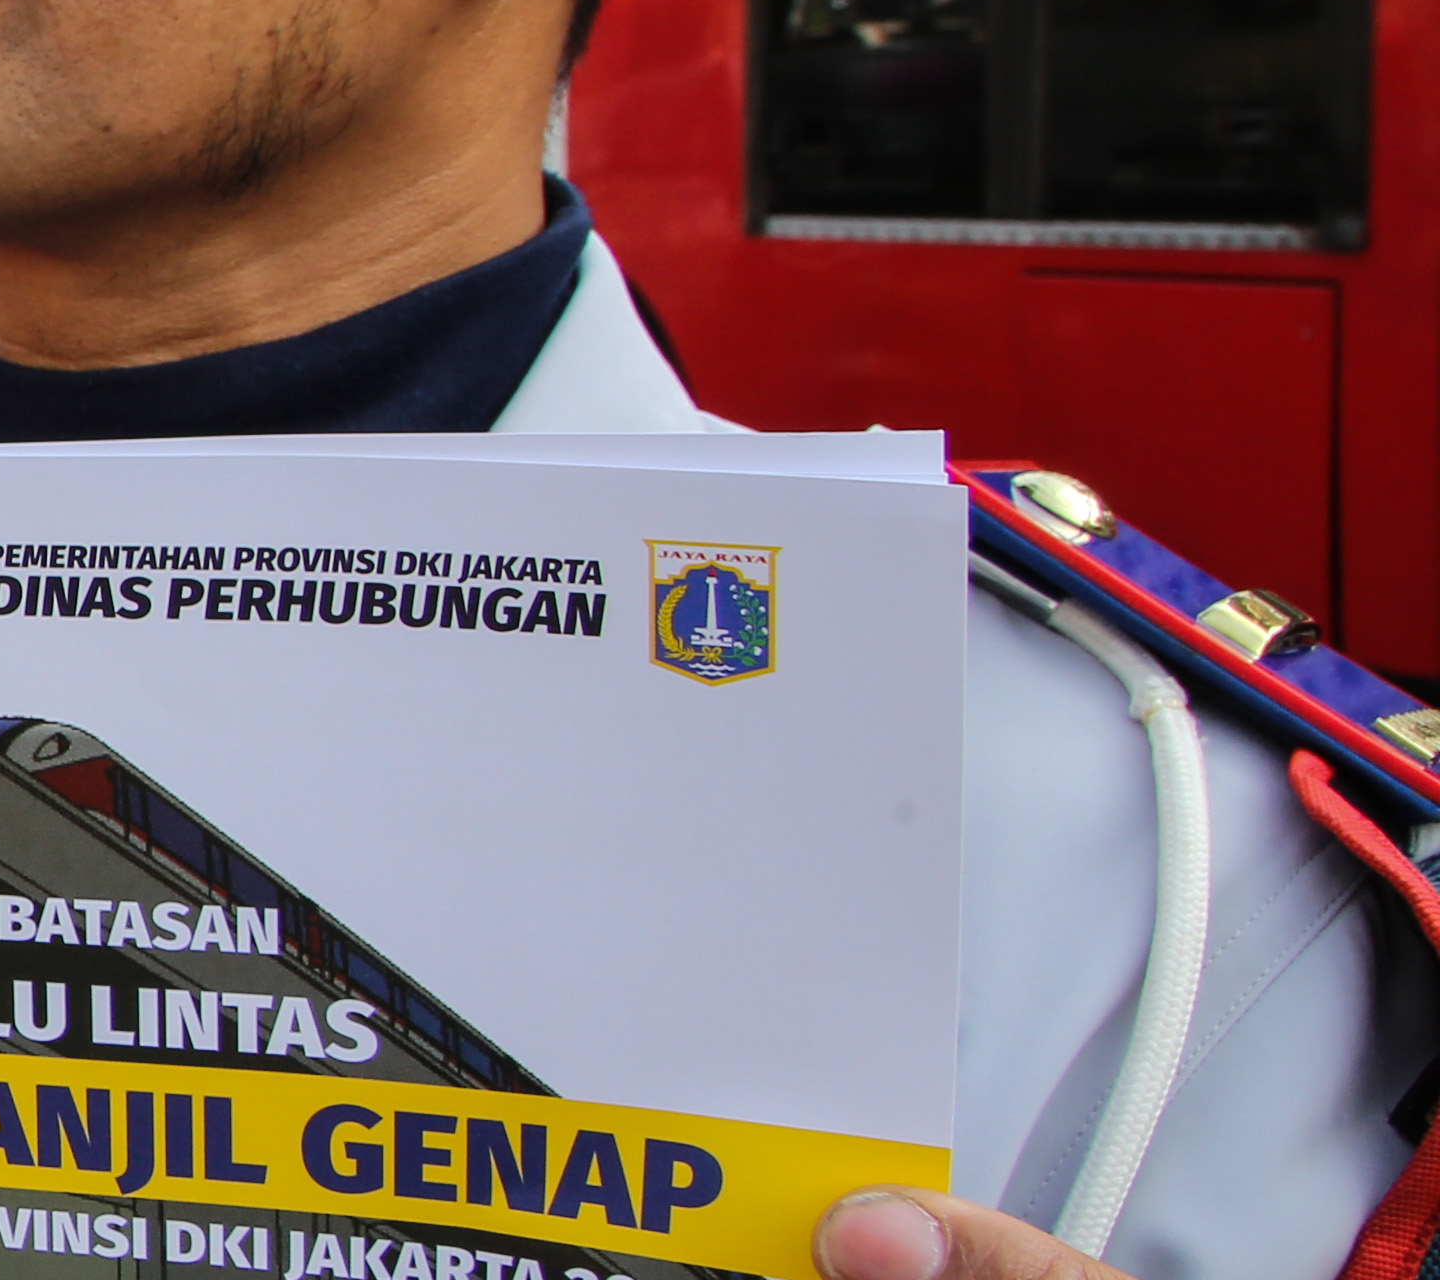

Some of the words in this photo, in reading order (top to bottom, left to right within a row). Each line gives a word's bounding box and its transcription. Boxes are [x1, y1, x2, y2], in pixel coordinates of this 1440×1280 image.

[233, 546, 388, 575] PROVINSI
[394, 550, 453, 579] DKI
[457, 552, 604, 586] JAKARTA
[658, 550, 707, 561] JAYA
[715, 553, 768, 564] RAYA
[166, 577, 608, 638] PERHUBUNGAN
[90, 984, 380, 1064] LINTAS
[299, 1102, 725, 1236] GENAP
[165, 1220, 272, 1272] DKI
